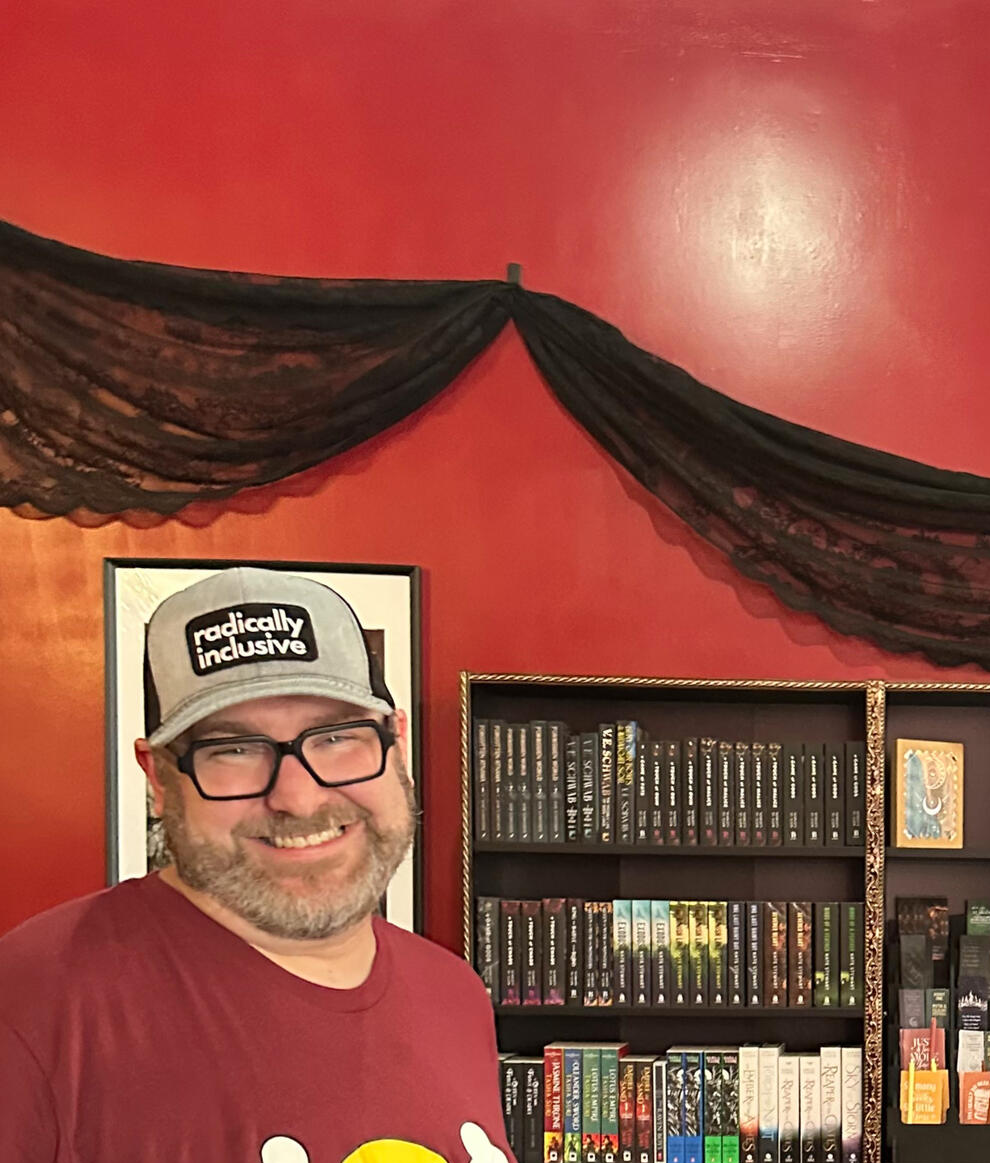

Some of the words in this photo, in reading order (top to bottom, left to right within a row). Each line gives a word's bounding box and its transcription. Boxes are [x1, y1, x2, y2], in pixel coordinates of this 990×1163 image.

[193, 608, 304, 646] radically
[196, 633, 307, 669] inclusive
[602, 750, 612, 796] SCHWAB
[552, 1062, 560, 1094] JASMINE
[821, 1066, 838, 1104] REAPER
[844, 1065, 860, 1089] SKY
[552, 1096, 560, 1128] THRONE
